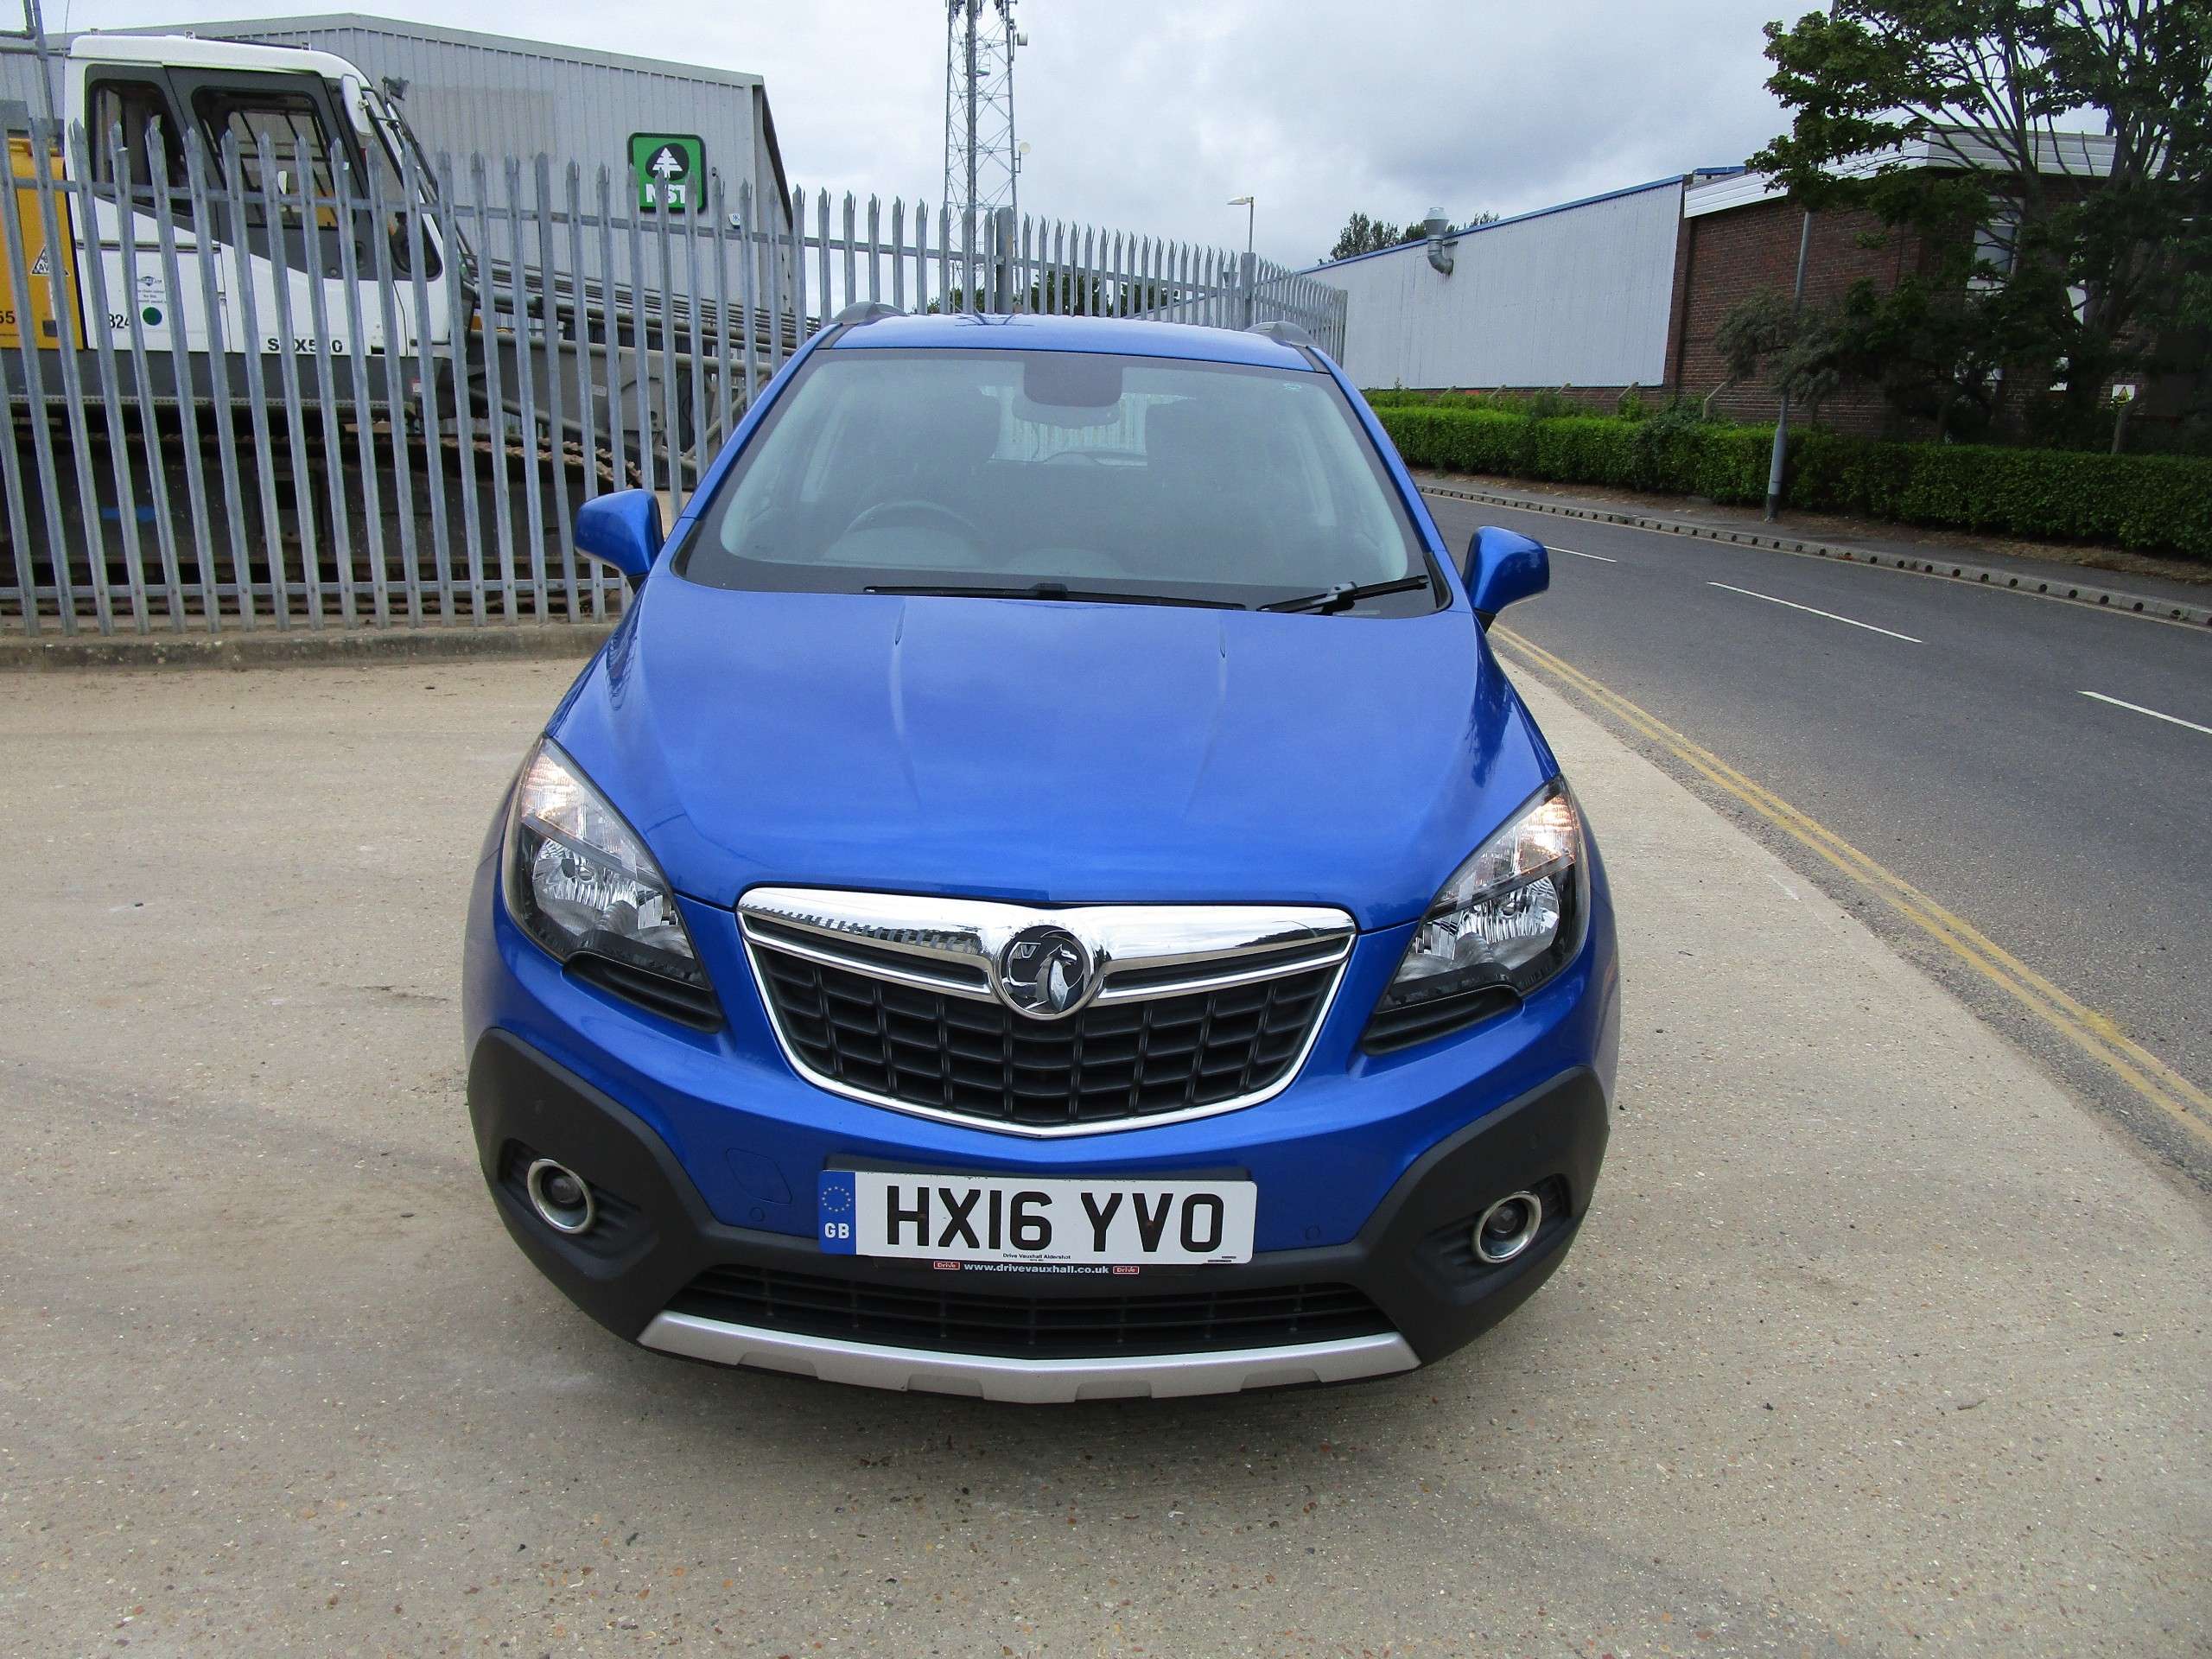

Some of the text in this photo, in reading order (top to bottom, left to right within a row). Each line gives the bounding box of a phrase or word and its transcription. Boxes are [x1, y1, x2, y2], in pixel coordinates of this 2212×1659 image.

[267, 337, 343, 353] SX50
[887, 1185, 1224, 1253] HX16 YVO
[823, 1222, 850, 1240] GB
[963, 1262, 1109, 1274] www.drivevauxhall.co.uk
